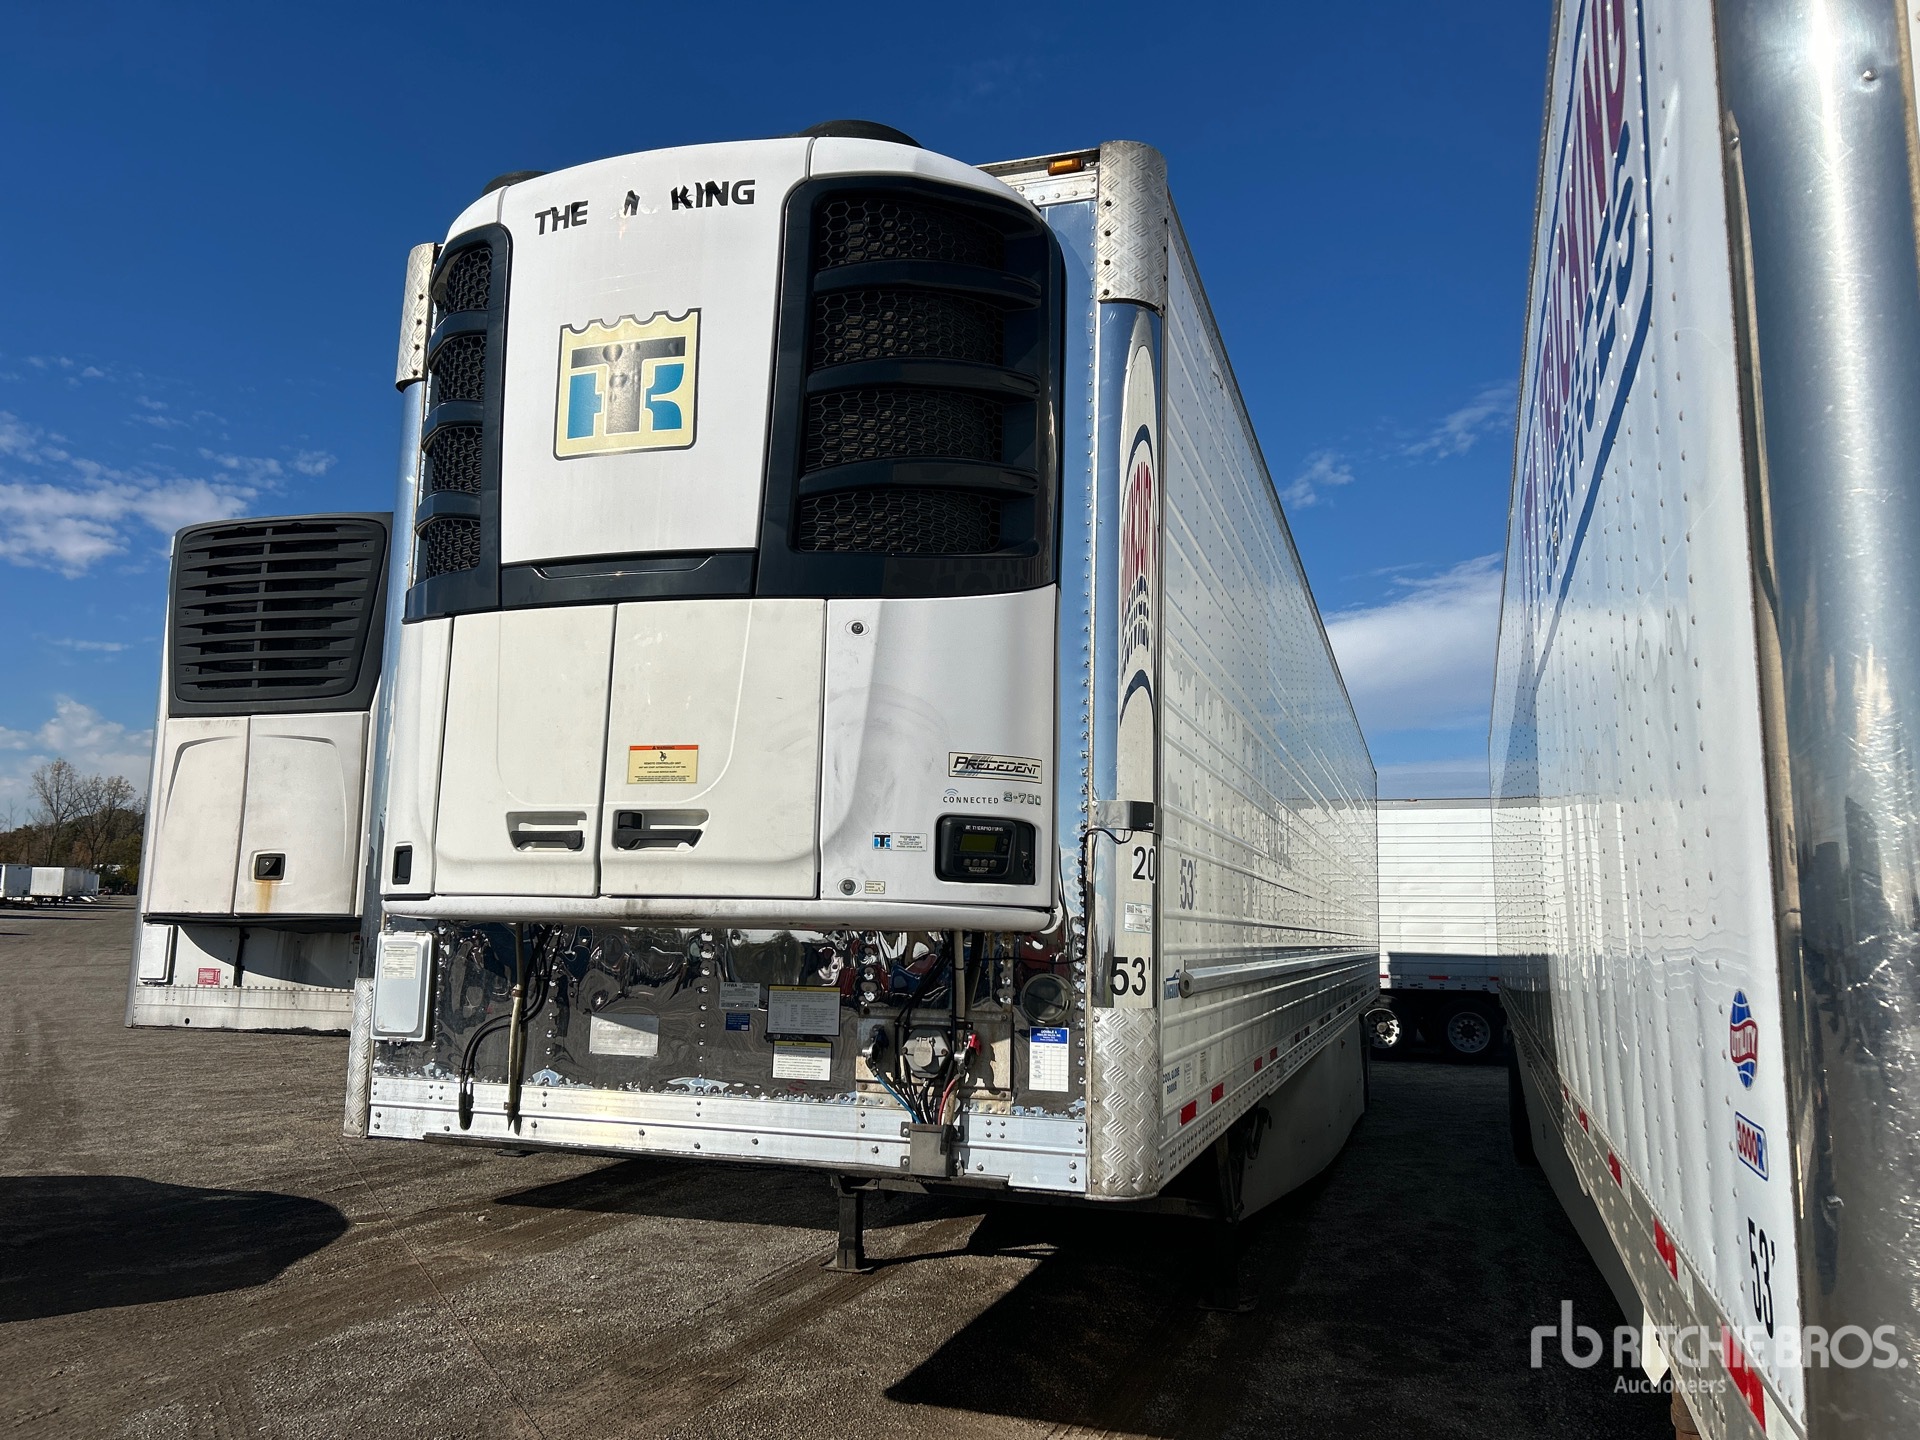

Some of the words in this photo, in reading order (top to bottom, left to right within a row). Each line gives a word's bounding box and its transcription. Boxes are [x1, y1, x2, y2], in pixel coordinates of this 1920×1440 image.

[670, 179, 756, 211] KING
[953, 756, 1040, 775] PRECEDENT
[942, 796, 999, 804] CONNECTED
[1132, 846, 1155, 881] 20
[1731, 1025, 1757, 1059] UTILITY
[1737, 1120, 1766, 1173] 3000R
